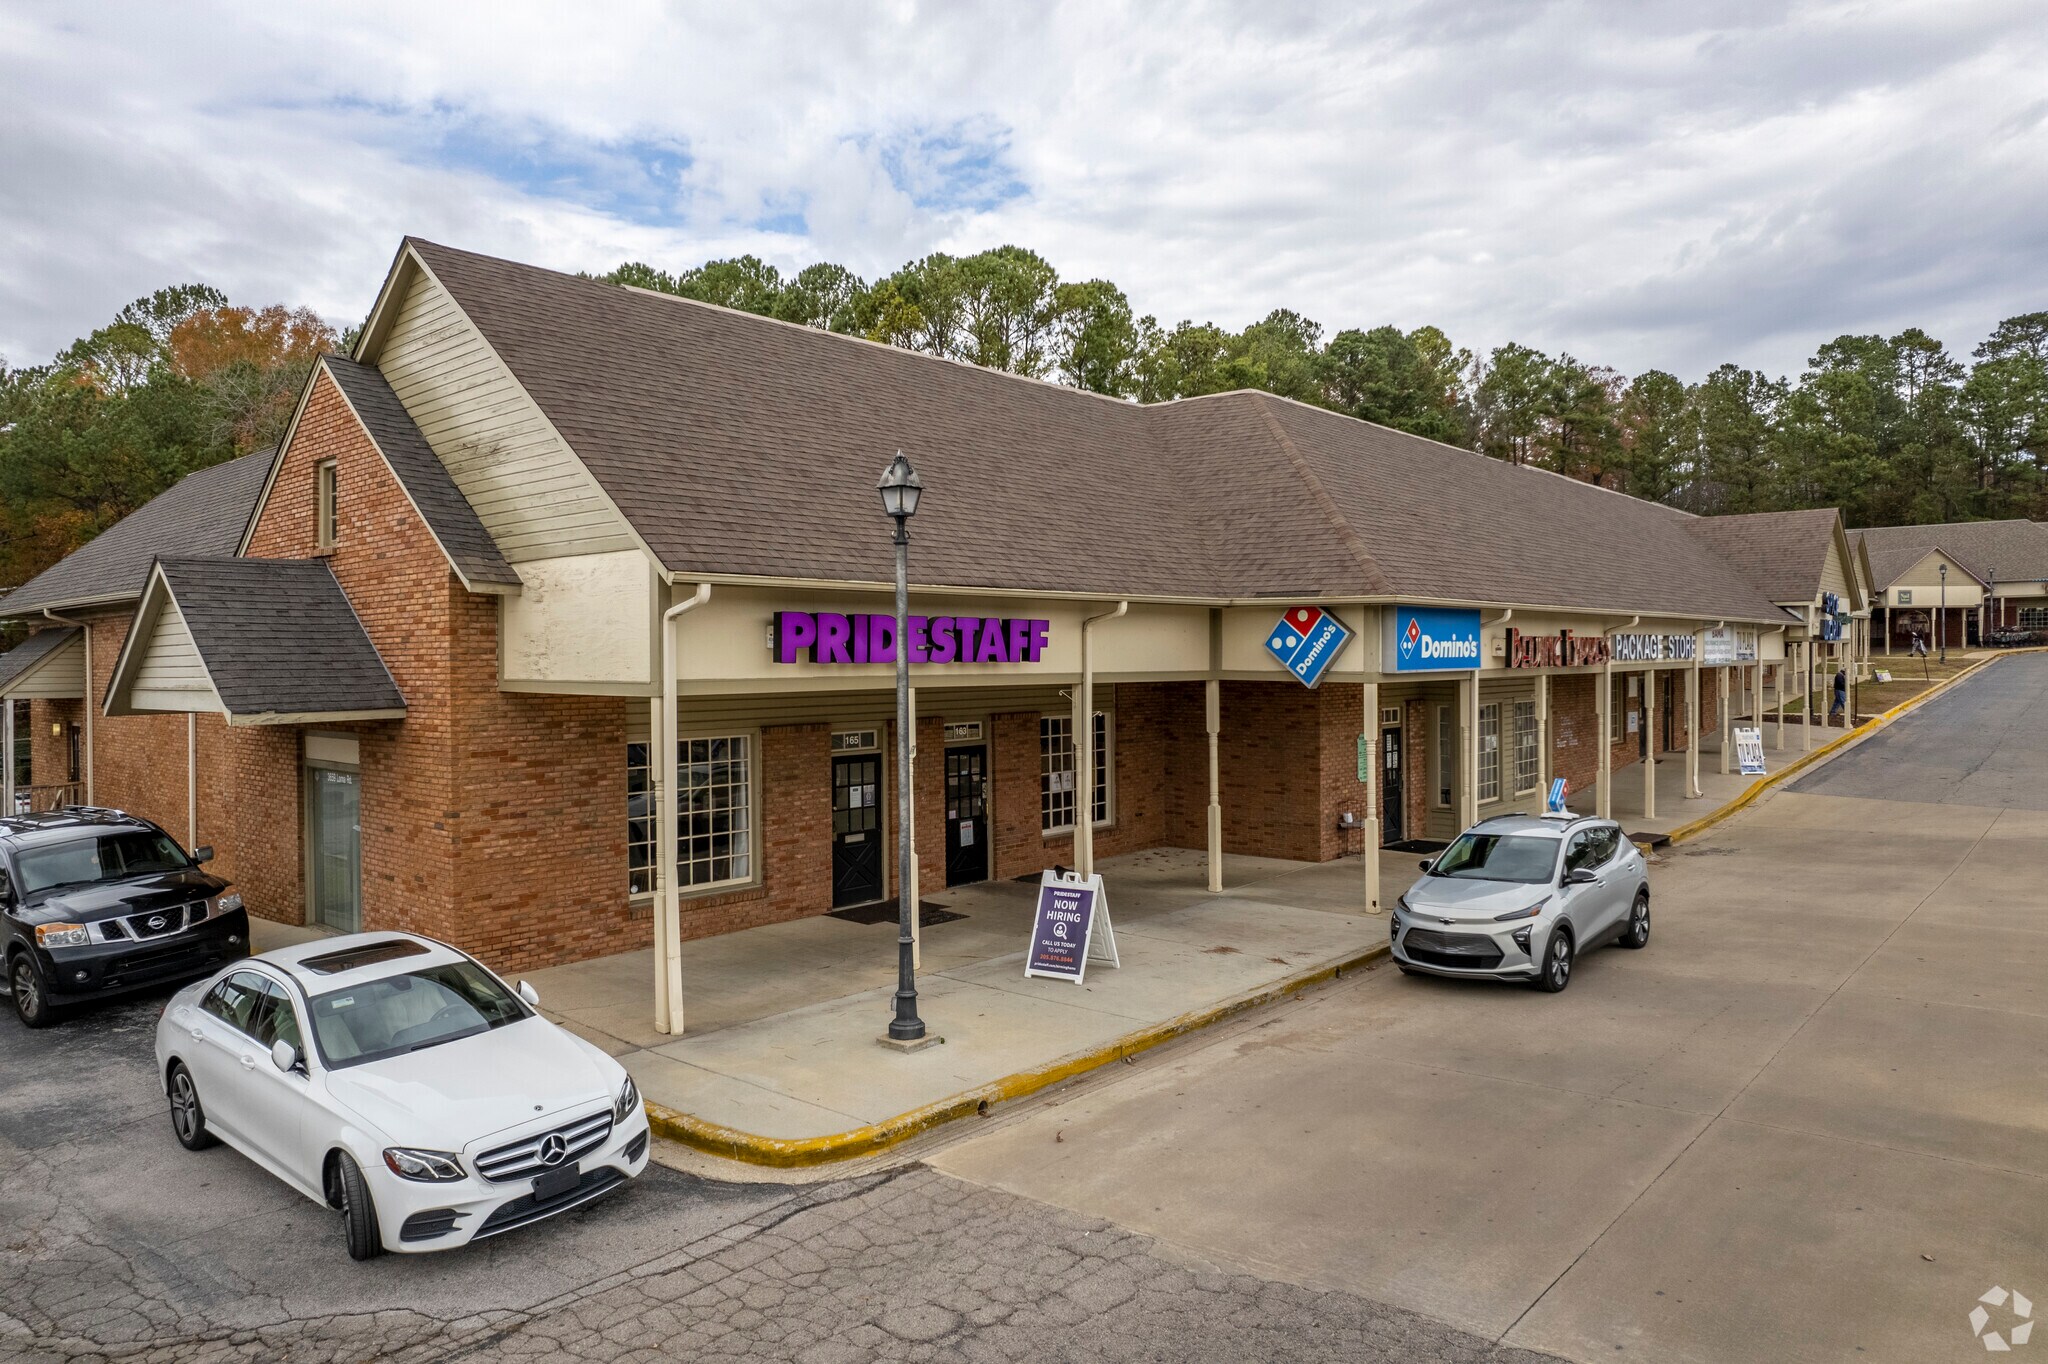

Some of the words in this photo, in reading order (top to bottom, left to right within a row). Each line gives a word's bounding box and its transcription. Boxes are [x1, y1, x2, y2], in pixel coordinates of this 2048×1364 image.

[775, 611, 1049, 664] PRIDESTAFF
[1295, 623, 1337, 676] Domino's
[1421, 633, 1478, 659] Domino's
[1615, 634, 1664, 660] PACKAGE
[1668, 635, 1696, 659] STORE
[955, 726, 967, 736] 163
[845, 735, 859, 745] 165
[1053, 890, 1081, 898] PRIDESTAFF
[1054, 899, 1078, 911] NOW
[1046, 910, 1081, 923] HIRING
